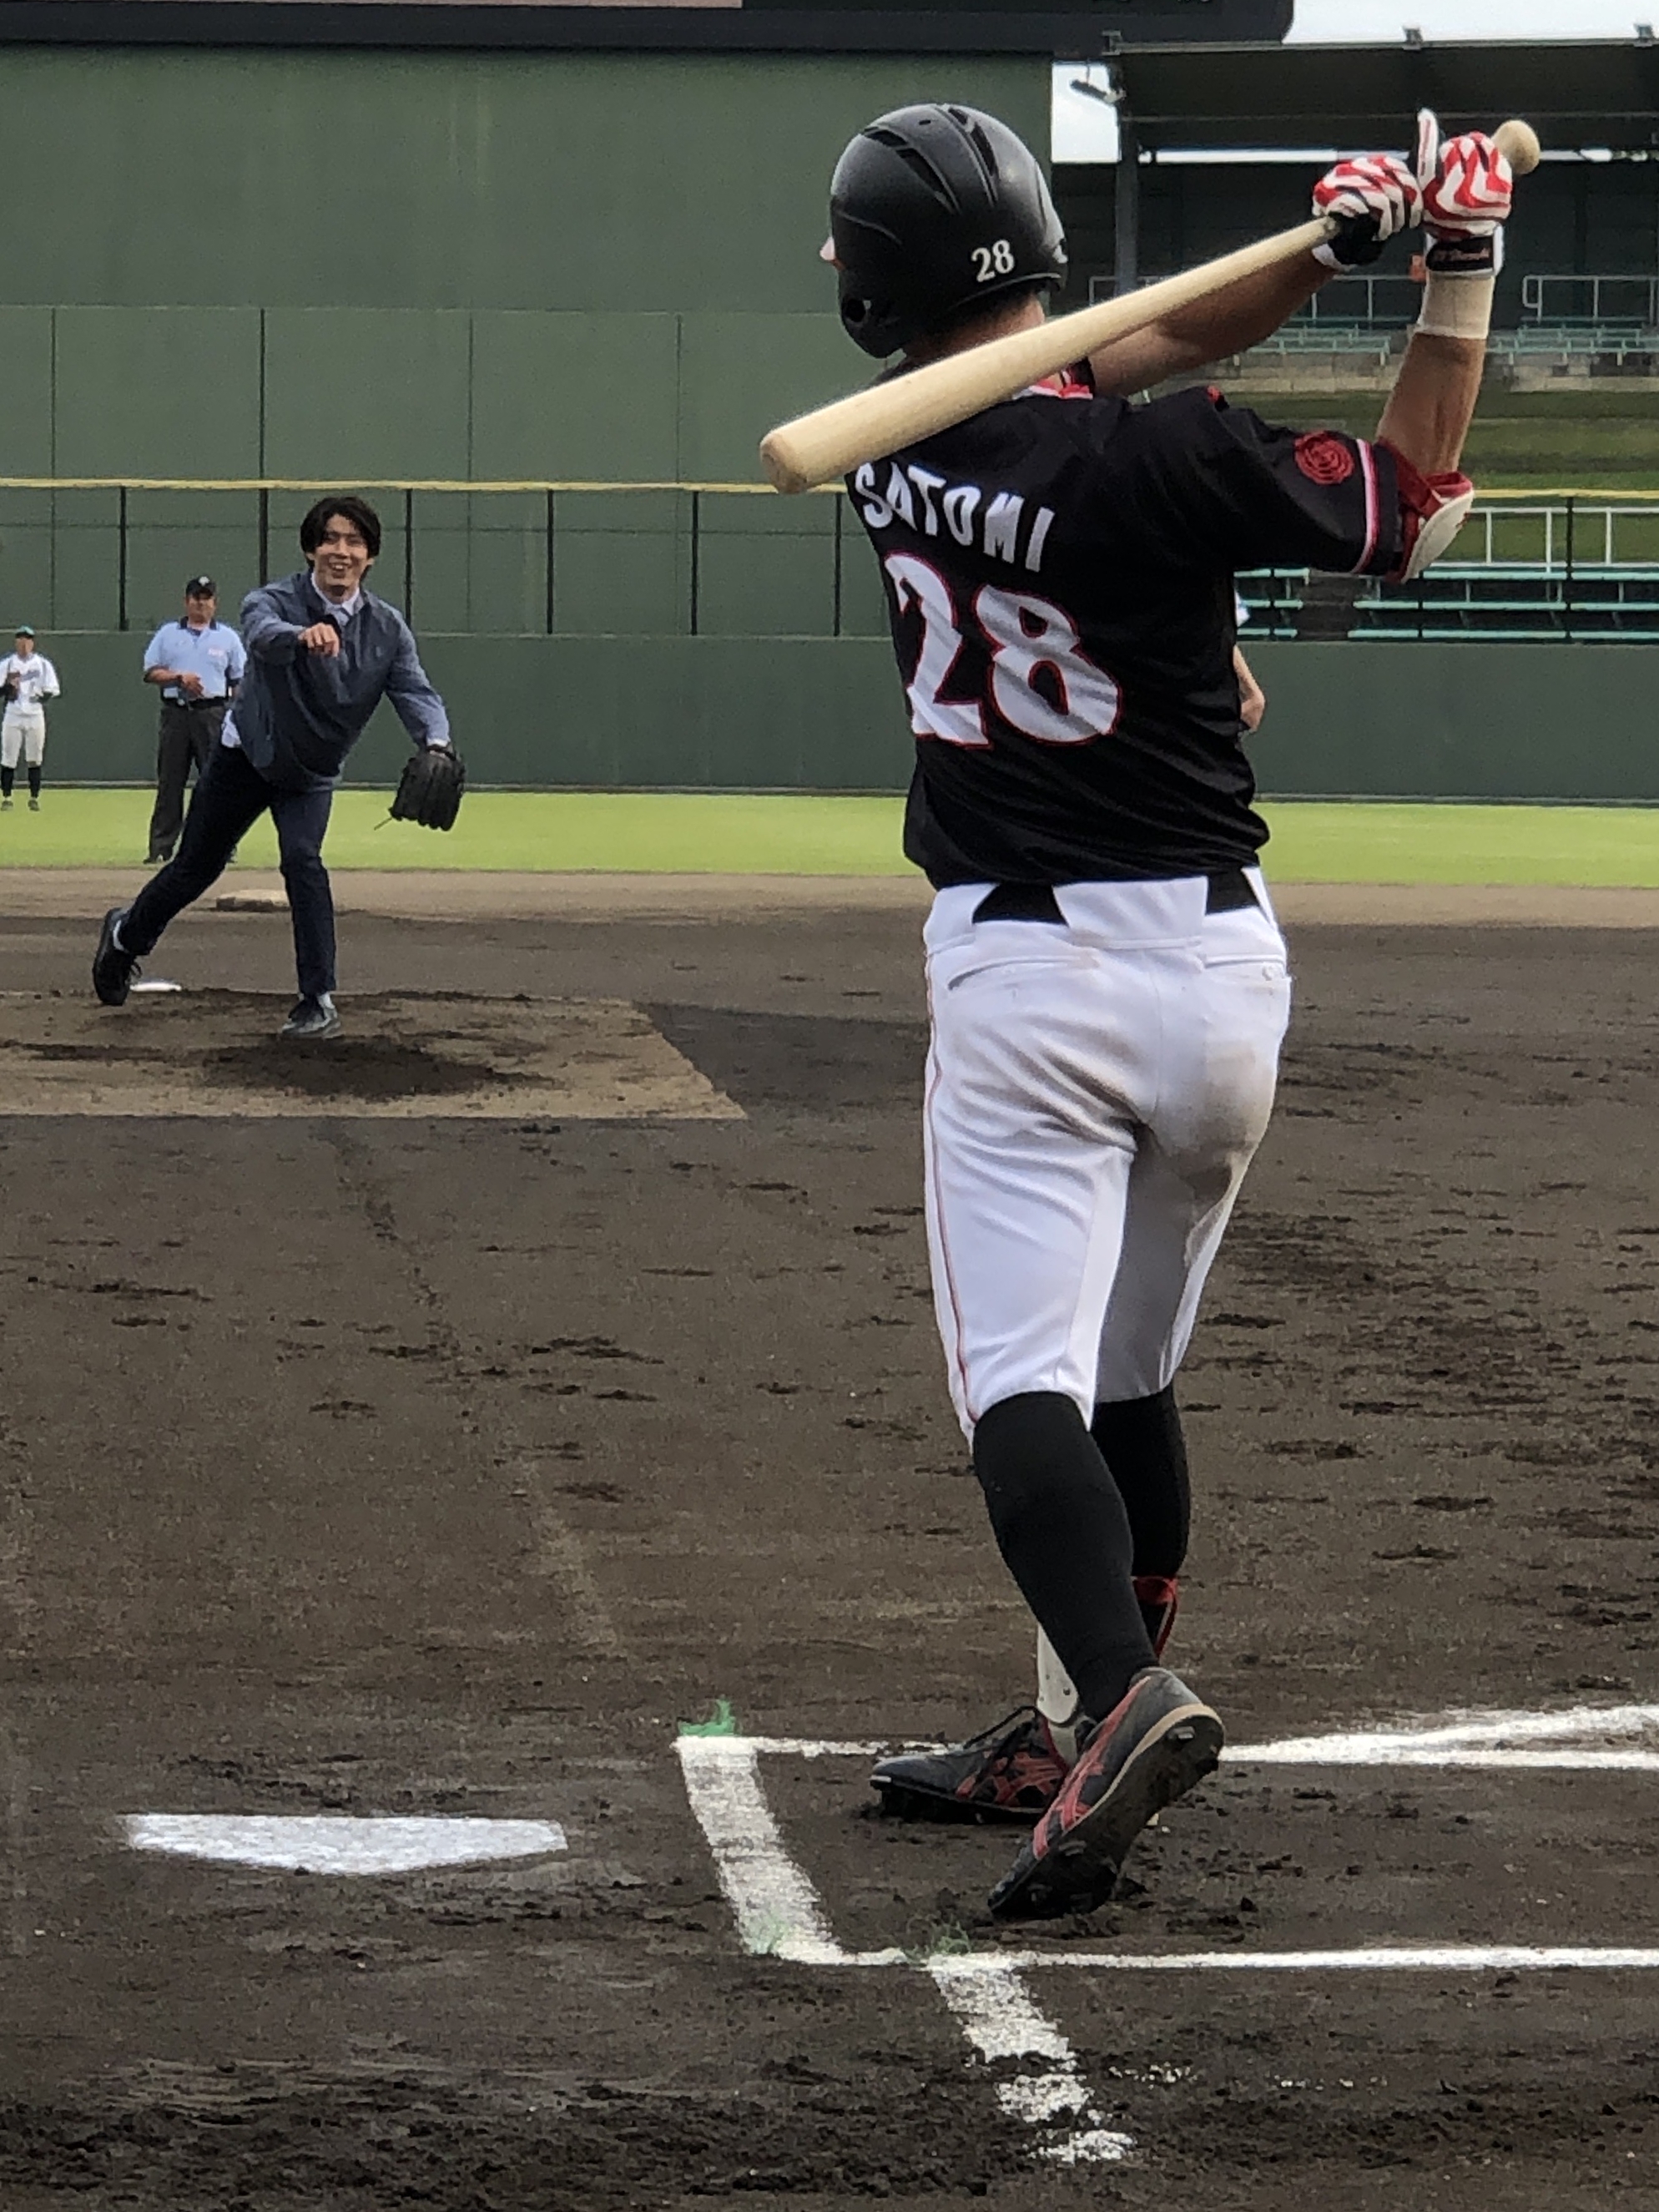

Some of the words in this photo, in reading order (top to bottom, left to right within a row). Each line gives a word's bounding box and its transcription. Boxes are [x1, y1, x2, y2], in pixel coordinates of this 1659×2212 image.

[971, 239, 1015, 282] 28
[855, 462, 1056, 573] SATOMI
[884, 549, 1123, 750] 28
